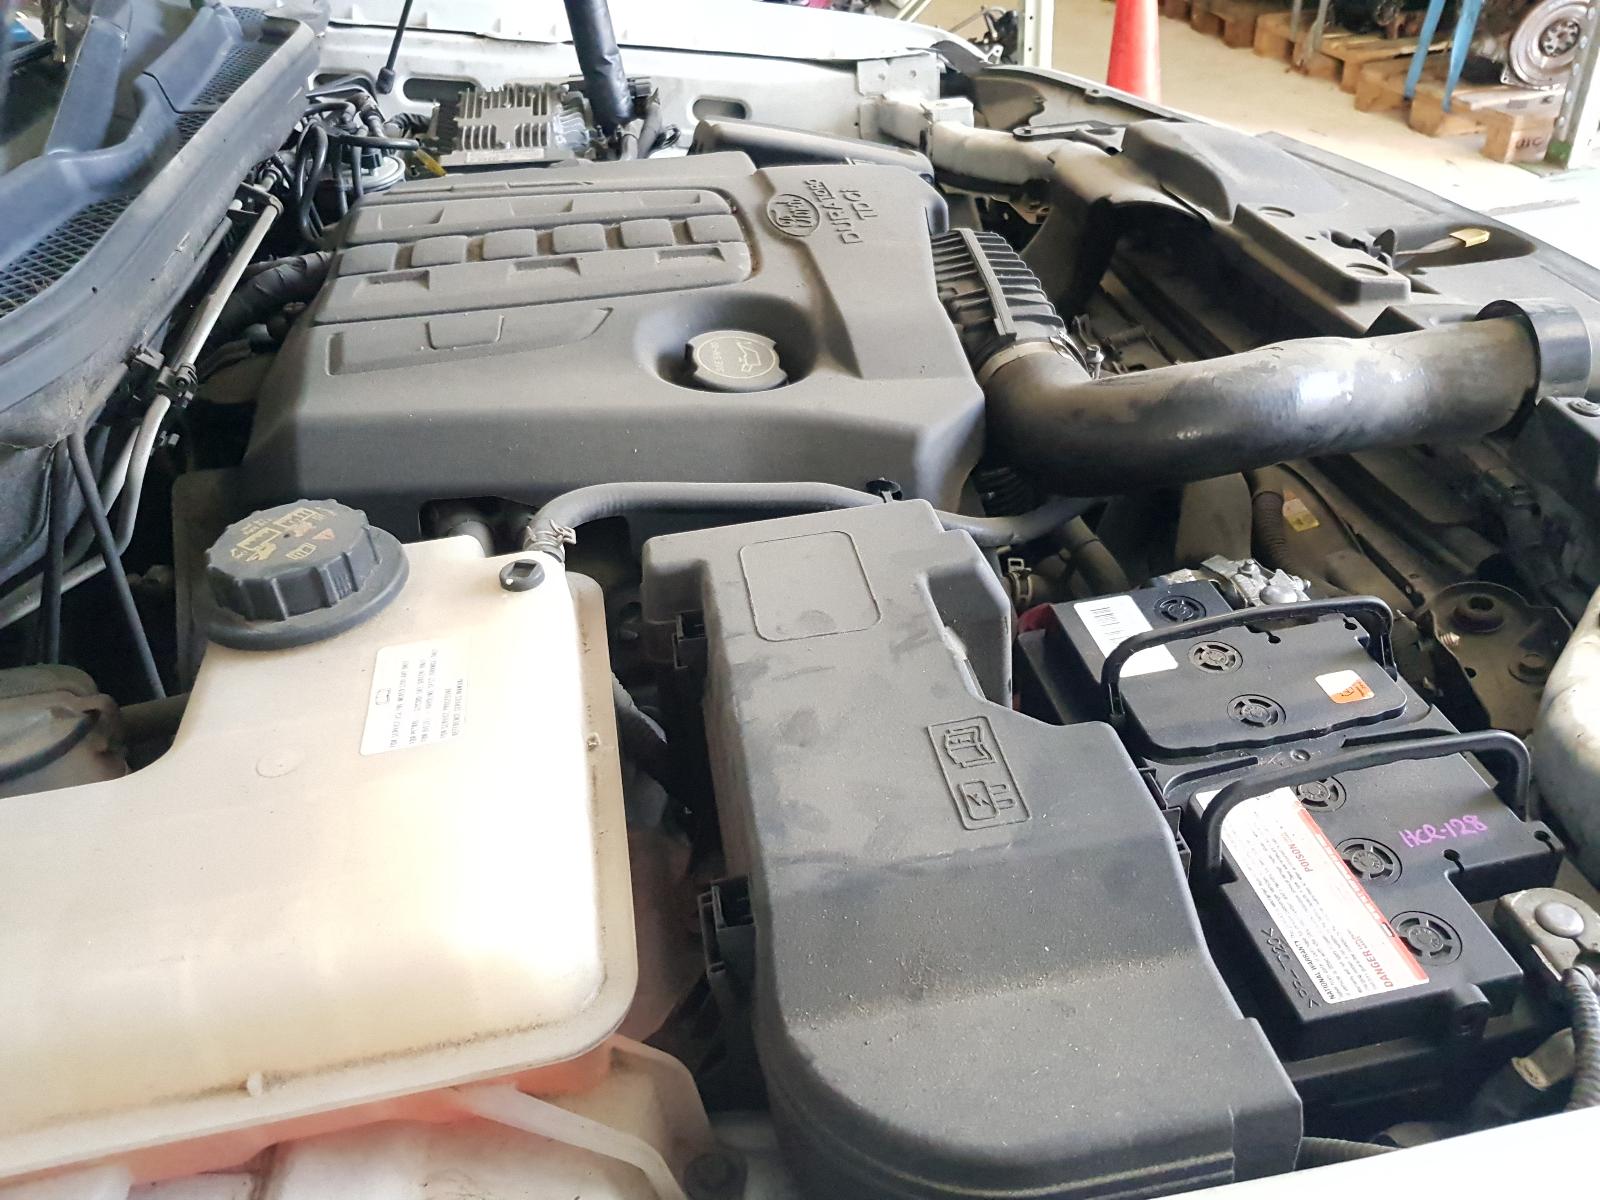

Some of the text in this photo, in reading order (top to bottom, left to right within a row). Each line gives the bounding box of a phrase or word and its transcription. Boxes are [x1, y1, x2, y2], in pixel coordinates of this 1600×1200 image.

[1398, 814, 1488, 848] HCR-128
[1287, 842, 1313, 872] POISON
[1293, 940, 1336, 1000] NATIONAL WARRANTY
[1361, 949, 1394, 988] DANGER
